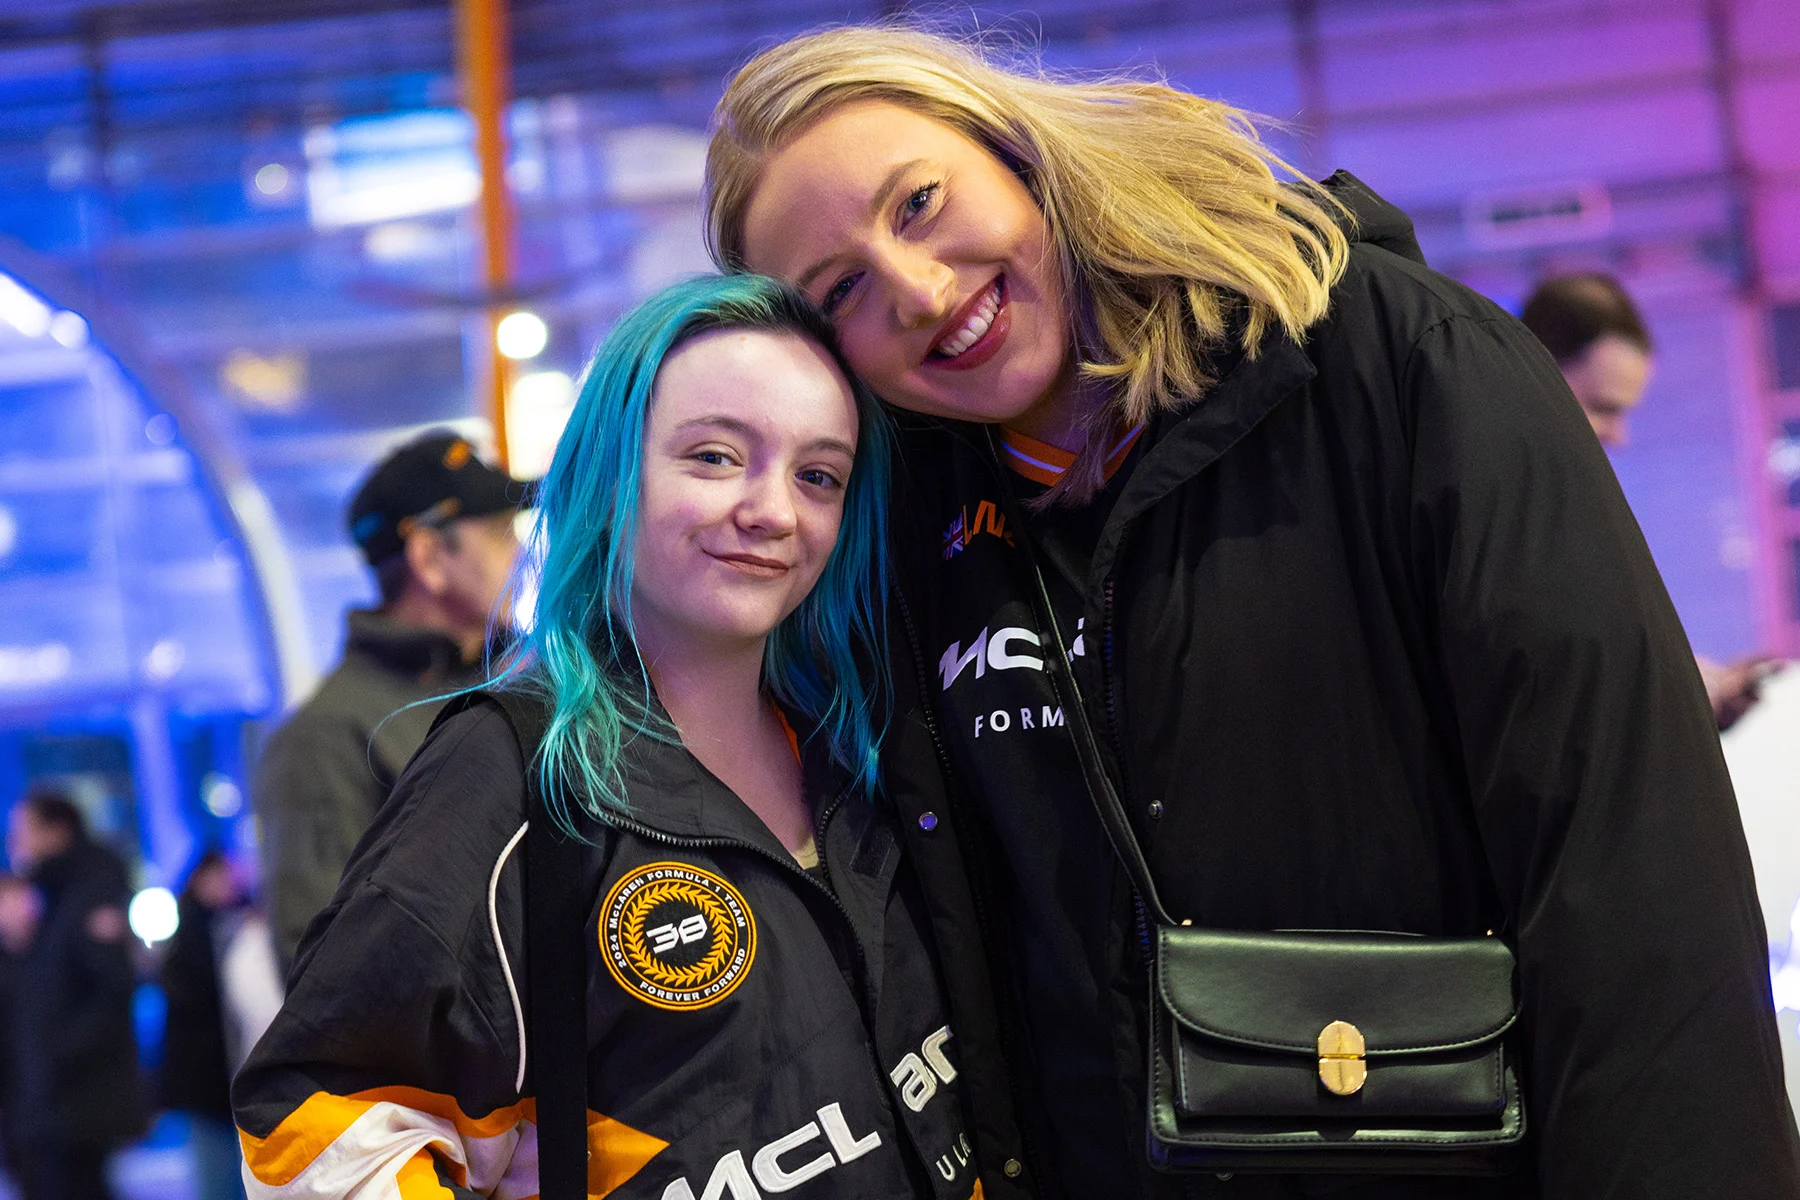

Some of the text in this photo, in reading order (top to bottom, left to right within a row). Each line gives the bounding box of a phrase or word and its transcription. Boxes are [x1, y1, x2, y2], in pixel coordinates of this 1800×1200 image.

[974, 705, 1065, 738] FORM
[609, 870, 746, 968] 2024 McLAREN FORMULA 1 TEAM
[639, 948, 746, 1001] FOREVER FORWARD
